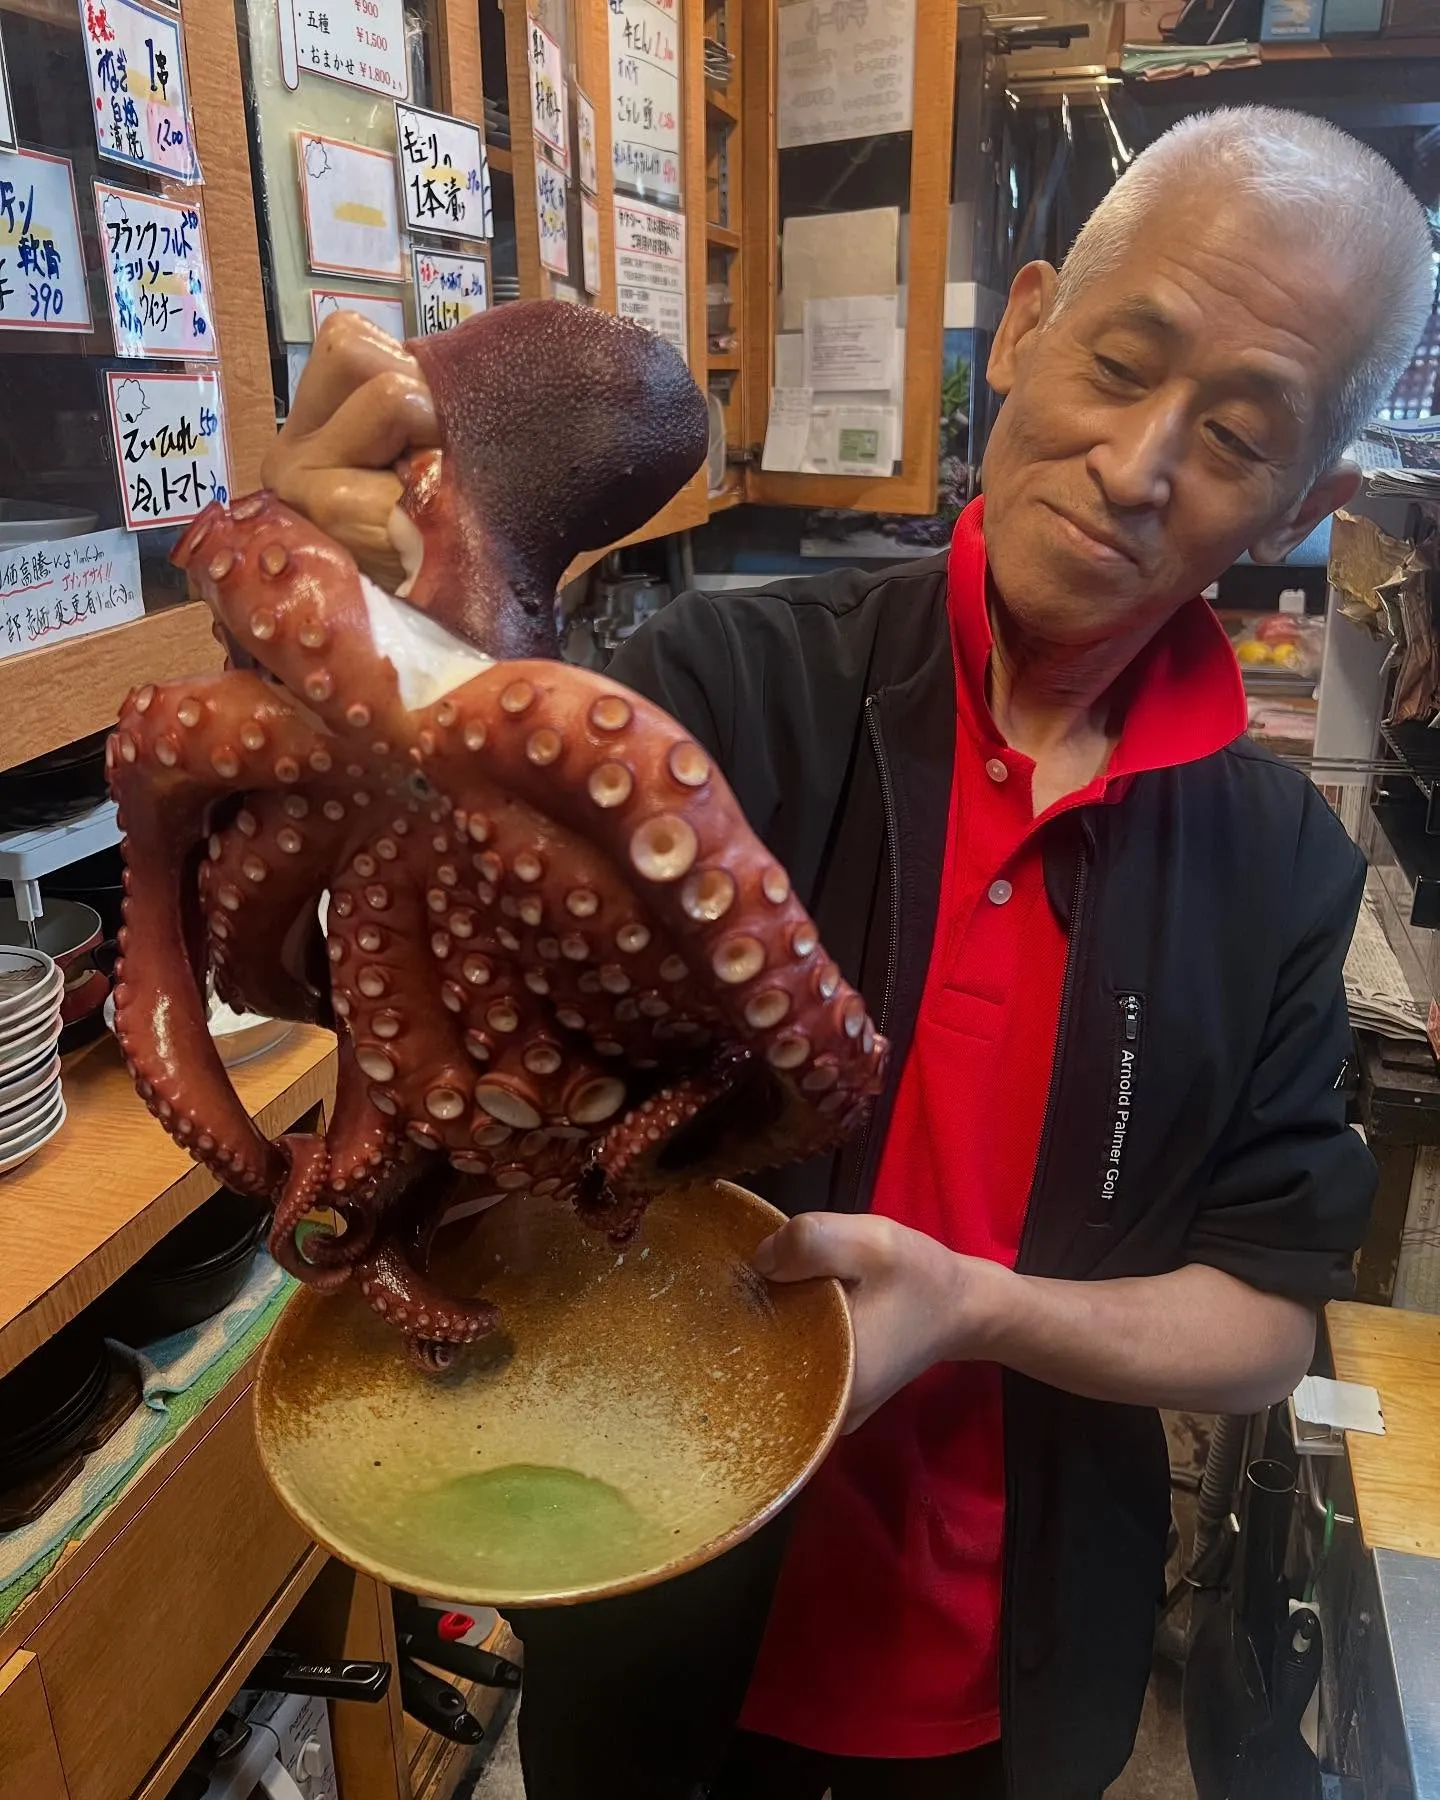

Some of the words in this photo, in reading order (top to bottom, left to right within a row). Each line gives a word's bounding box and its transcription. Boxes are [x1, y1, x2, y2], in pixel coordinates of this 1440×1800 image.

[355, 26, 388, 51] ¥1,500
[311, 45, 355, 75] おまかせ
[359, 61, 391, 85] ¥1,800
[28, 282, 63, 322] 390
[1118, 1049, 1135, 1106] Arnold
[1110, 1110, 1130, 1165] Palmer
[1101, 1168, 1119, 1200] Golf
